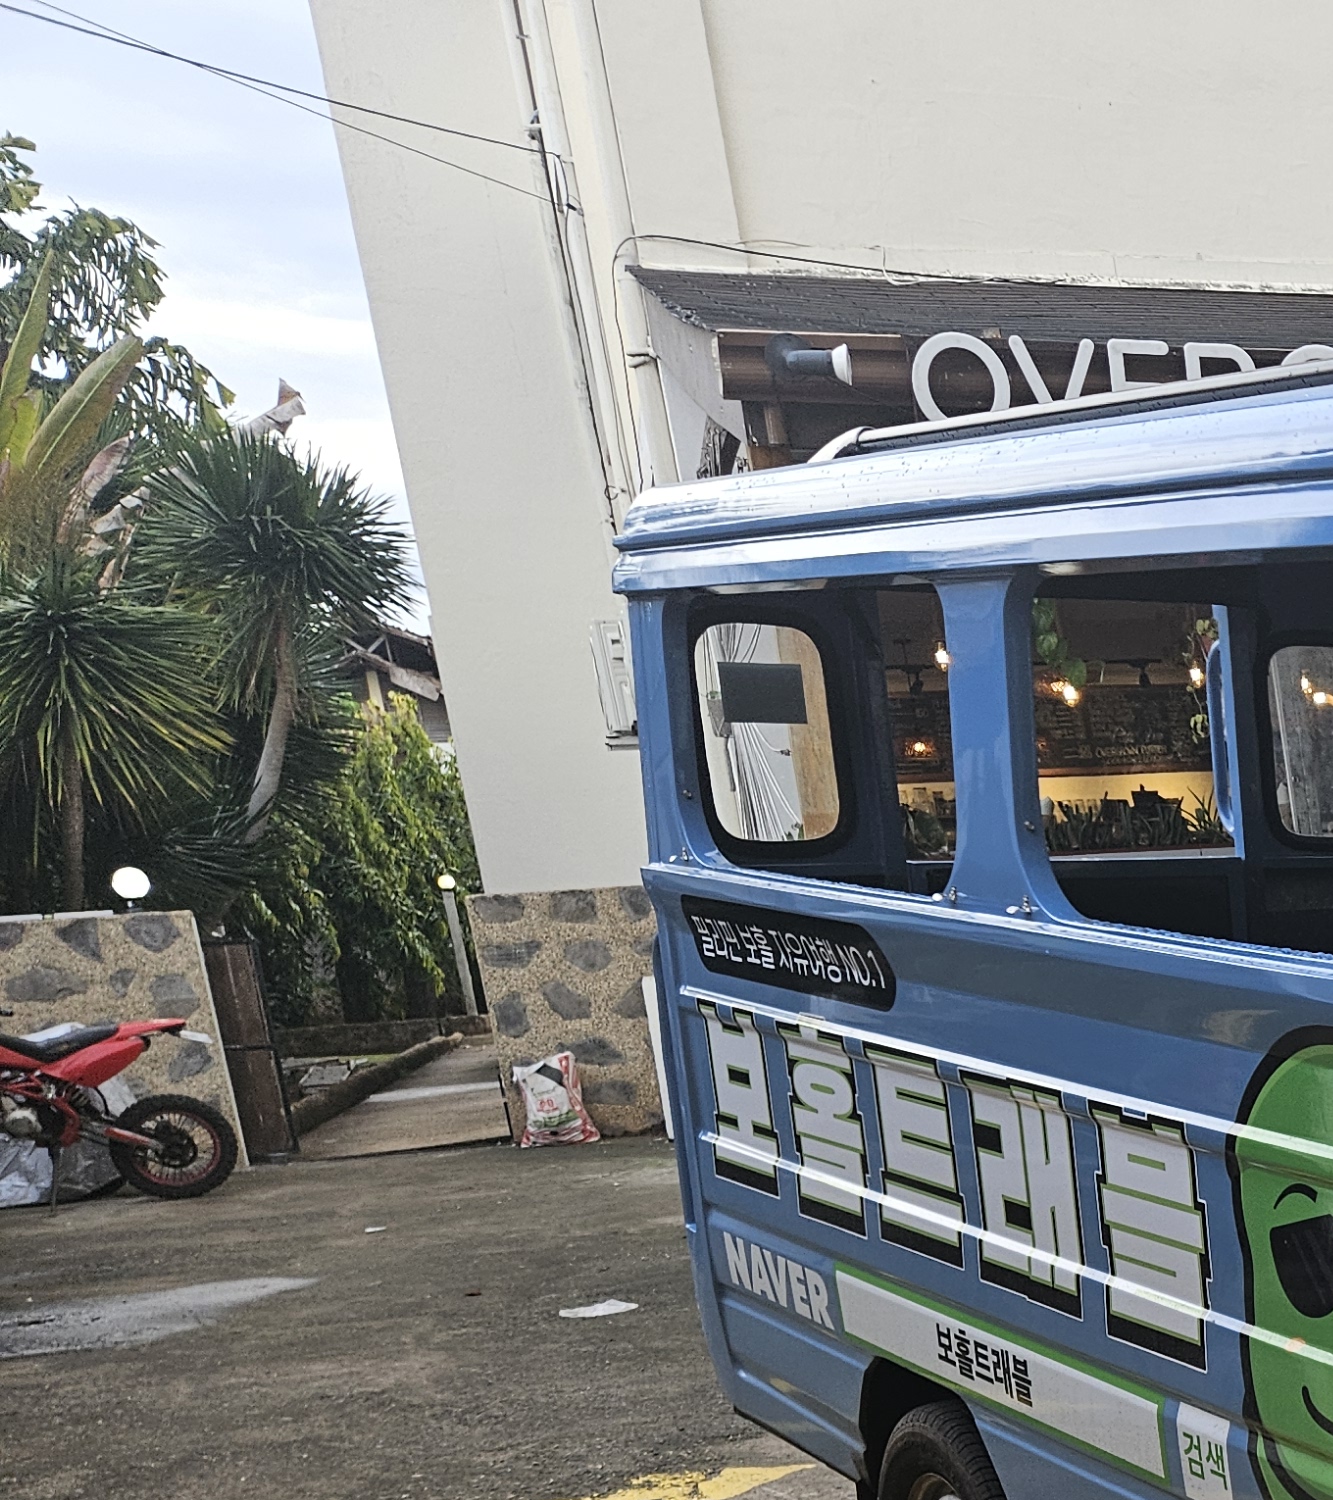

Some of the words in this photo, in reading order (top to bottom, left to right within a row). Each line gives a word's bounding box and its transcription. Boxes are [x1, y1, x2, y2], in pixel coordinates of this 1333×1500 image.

[691, 915, 743, 963] 필리핀
[736, 923, 775, 970] 보홀
[768, 930, 842, 983] 자유여행
[835, 943, 886, 989] NO.1
[697, 997, 1210, 1372] 보홀트래블
[723, 1231, 835, 1331] NAVER
[935, 1322, 1034, 1408] 보홀트래블
[1182, 1431, 1229, 1491] 검색
